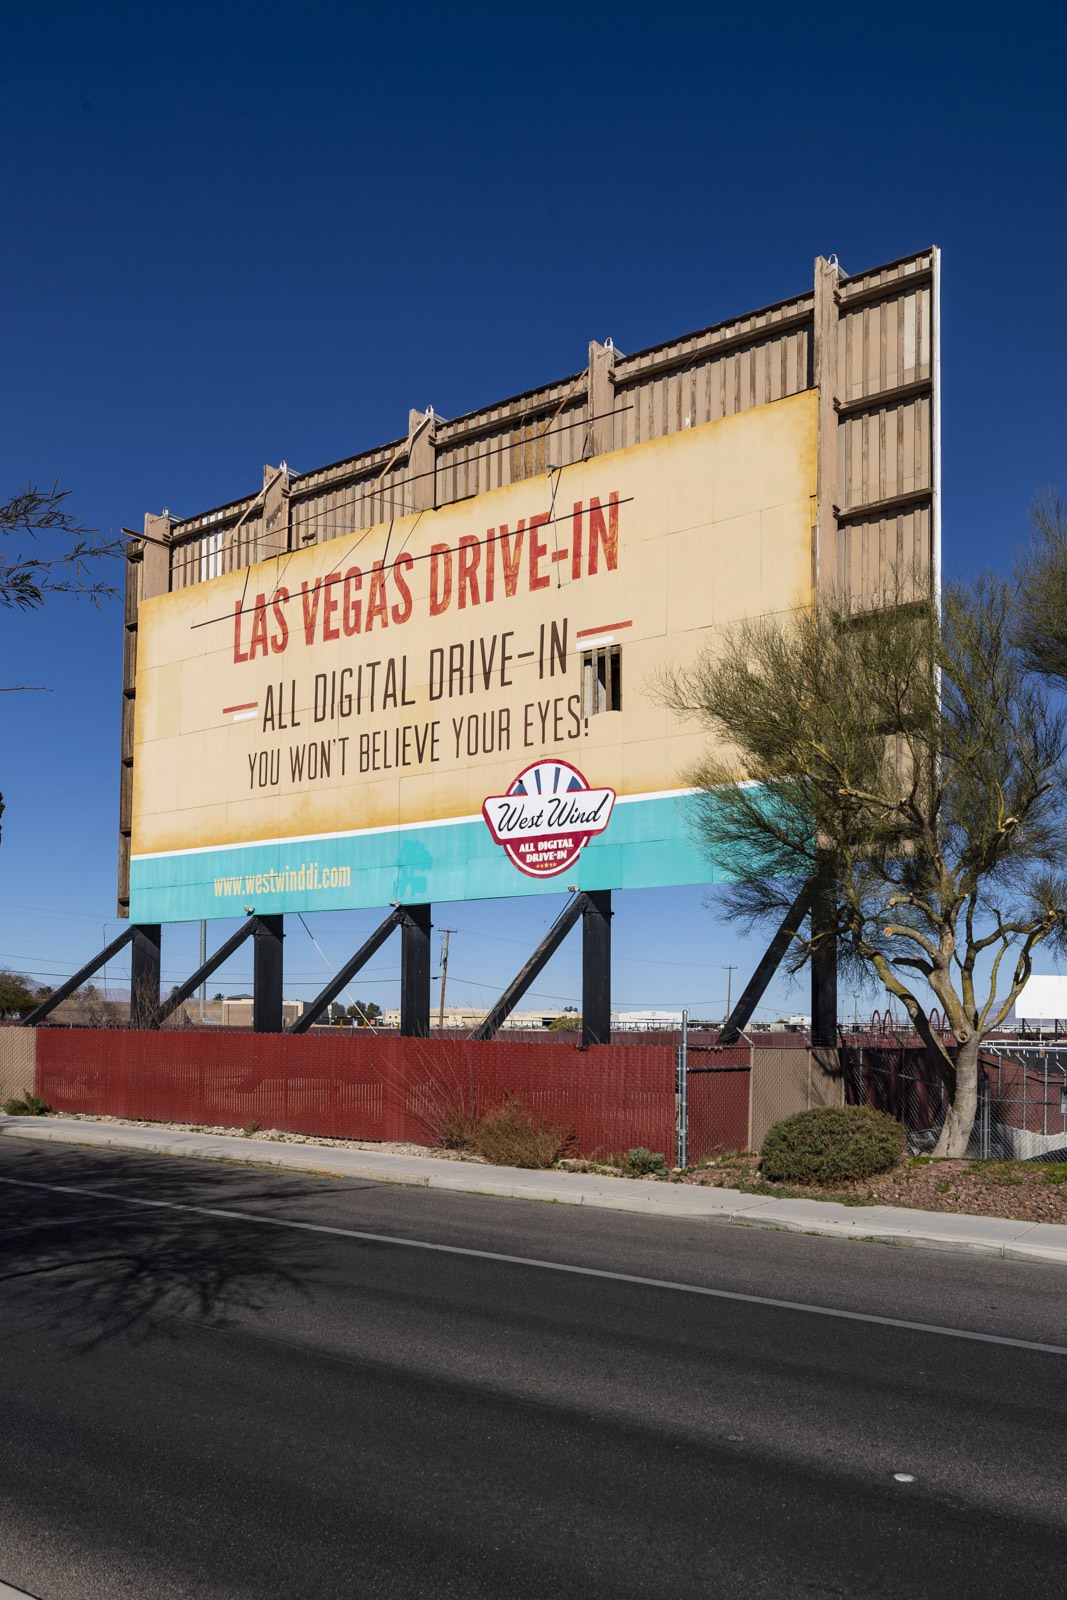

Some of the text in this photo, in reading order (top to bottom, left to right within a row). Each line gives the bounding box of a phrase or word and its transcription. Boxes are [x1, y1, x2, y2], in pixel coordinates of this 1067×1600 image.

[233, 490, 620, 664] LAS VEGAS DRIVE-IN
[262, 617, 569, 733] ALL DIGITAL DRIVE-IN
[248, 749, 281, 790] YOU
[289, 736, 350, 783] WON'T
[359, 720, 441, 773] BELIEVE
[452, 707, 511, 759] YOUR
[497, 793, 610, 832] West Wind
[519, 839, 574, 853] ALL DIGITAL
[526, 850, 567, 863] DRIVE-IN
[213, 862, 351, 897] www.westwinddi.com
